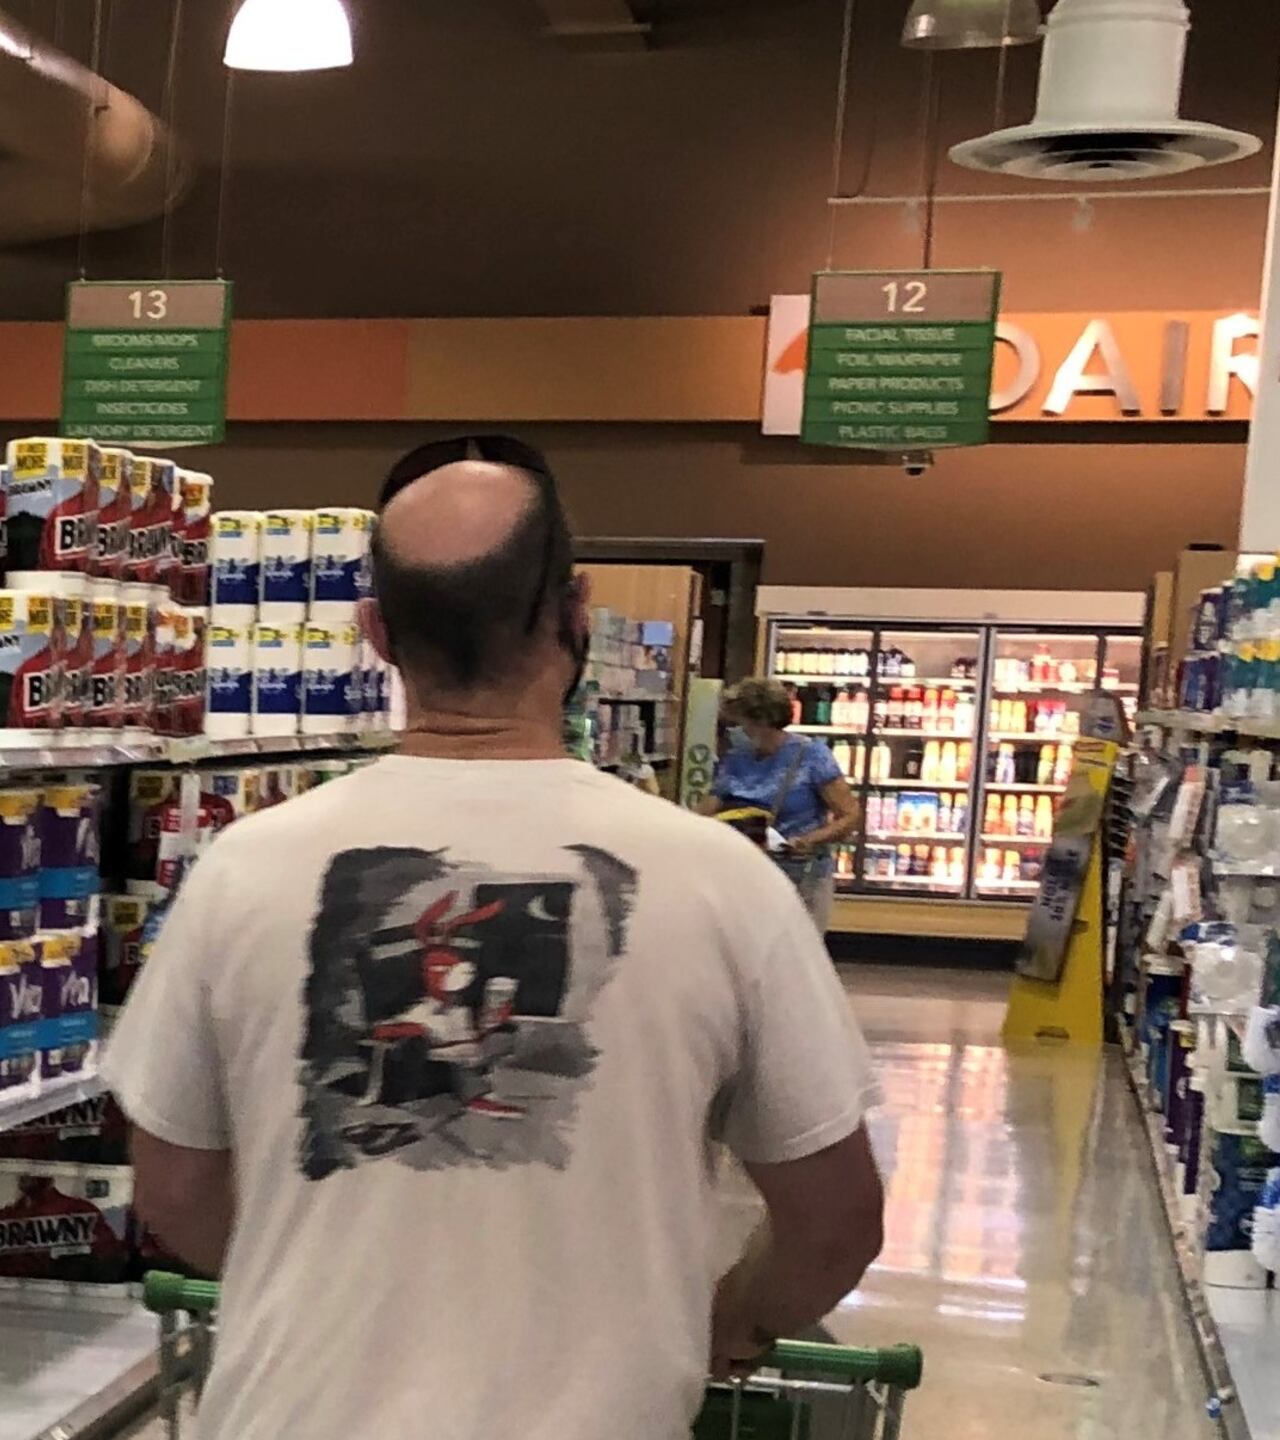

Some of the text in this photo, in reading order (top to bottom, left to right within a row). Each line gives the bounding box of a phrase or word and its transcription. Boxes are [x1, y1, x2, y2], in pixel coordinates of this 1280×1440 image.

[128, 289, 168, 320] 13
[881, 281, 928, 313] 12
[109, 357, 180, 370] CLEANERS
